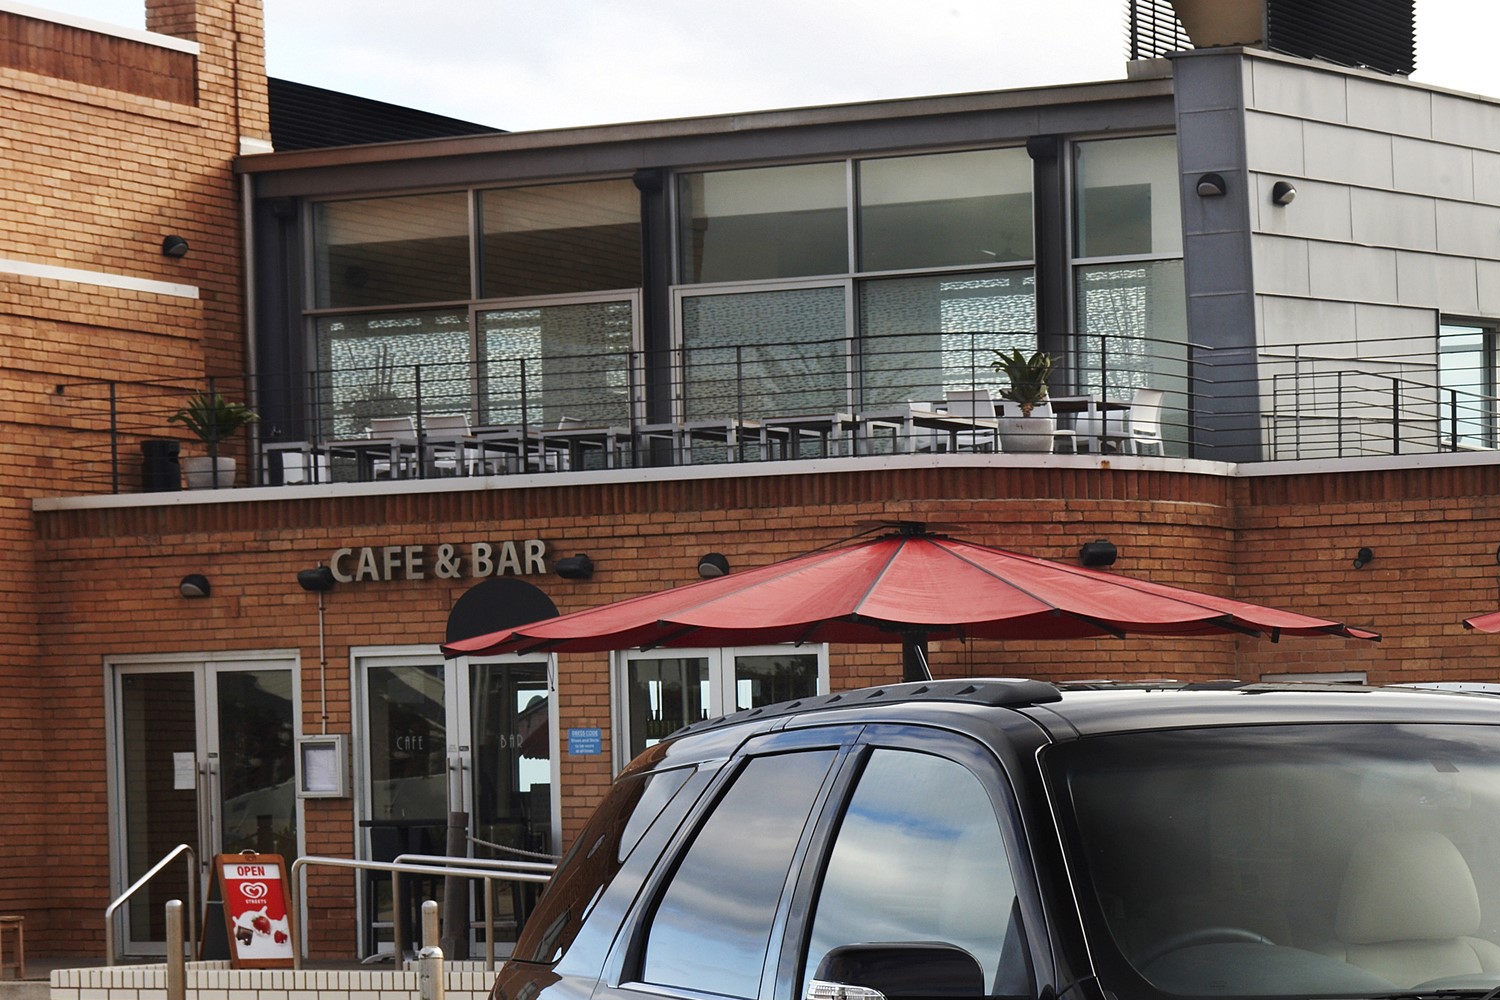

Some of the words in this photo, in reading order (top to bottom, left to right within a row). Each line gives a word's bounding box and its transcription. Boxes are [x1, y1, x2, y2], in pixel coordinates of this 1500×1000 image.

[330, 546, 425, 583] CAFE
[434, 543, 462, 580] &
[471, 538, 547, 578] BAR
[396, 735, 424, 750] CAFE
[500, 734, 524, 749] BAR
[237, 866, 265, 876] OPEN
